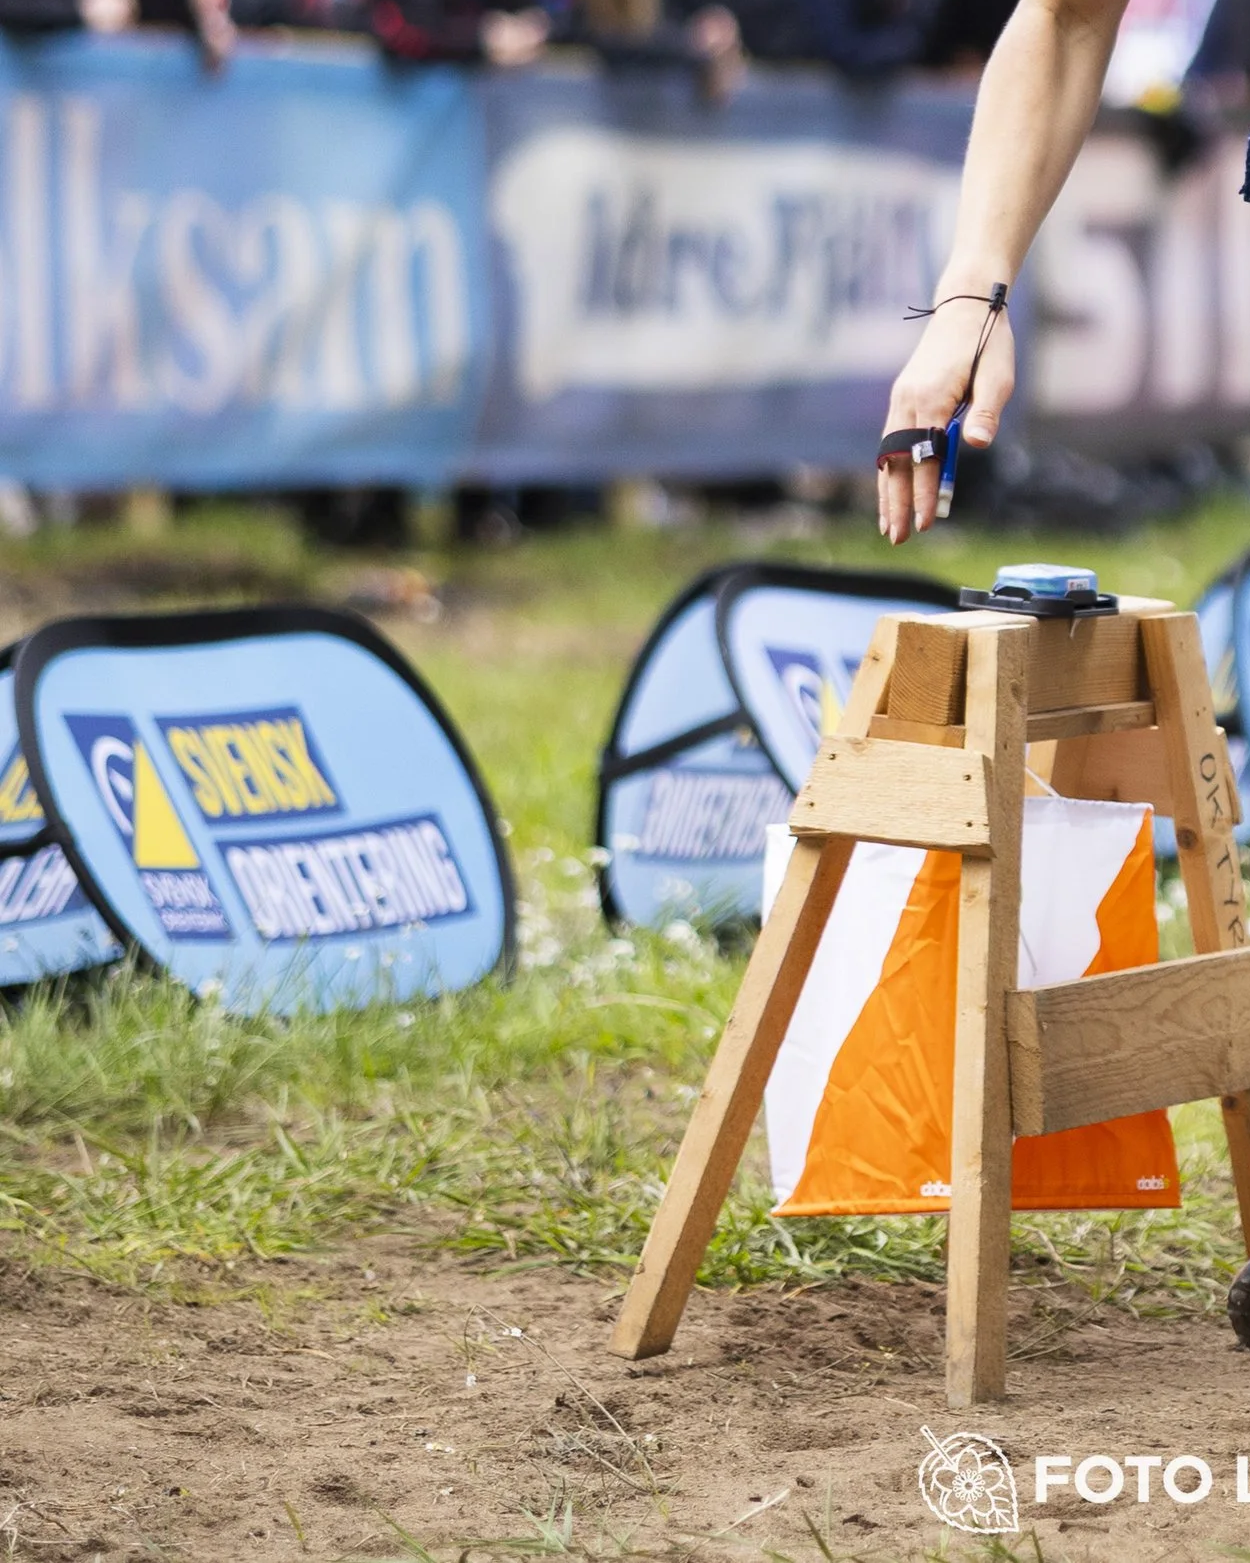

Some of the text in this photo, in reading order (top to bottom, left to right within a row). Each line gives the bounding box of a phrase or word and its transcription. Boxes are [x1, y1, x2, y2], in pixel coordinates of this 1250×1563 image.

[0, 93, 472, 416] lksam
[167, 716, 337, 818] SVENSK
[224, 819, 469, 938] ORIENTERING
